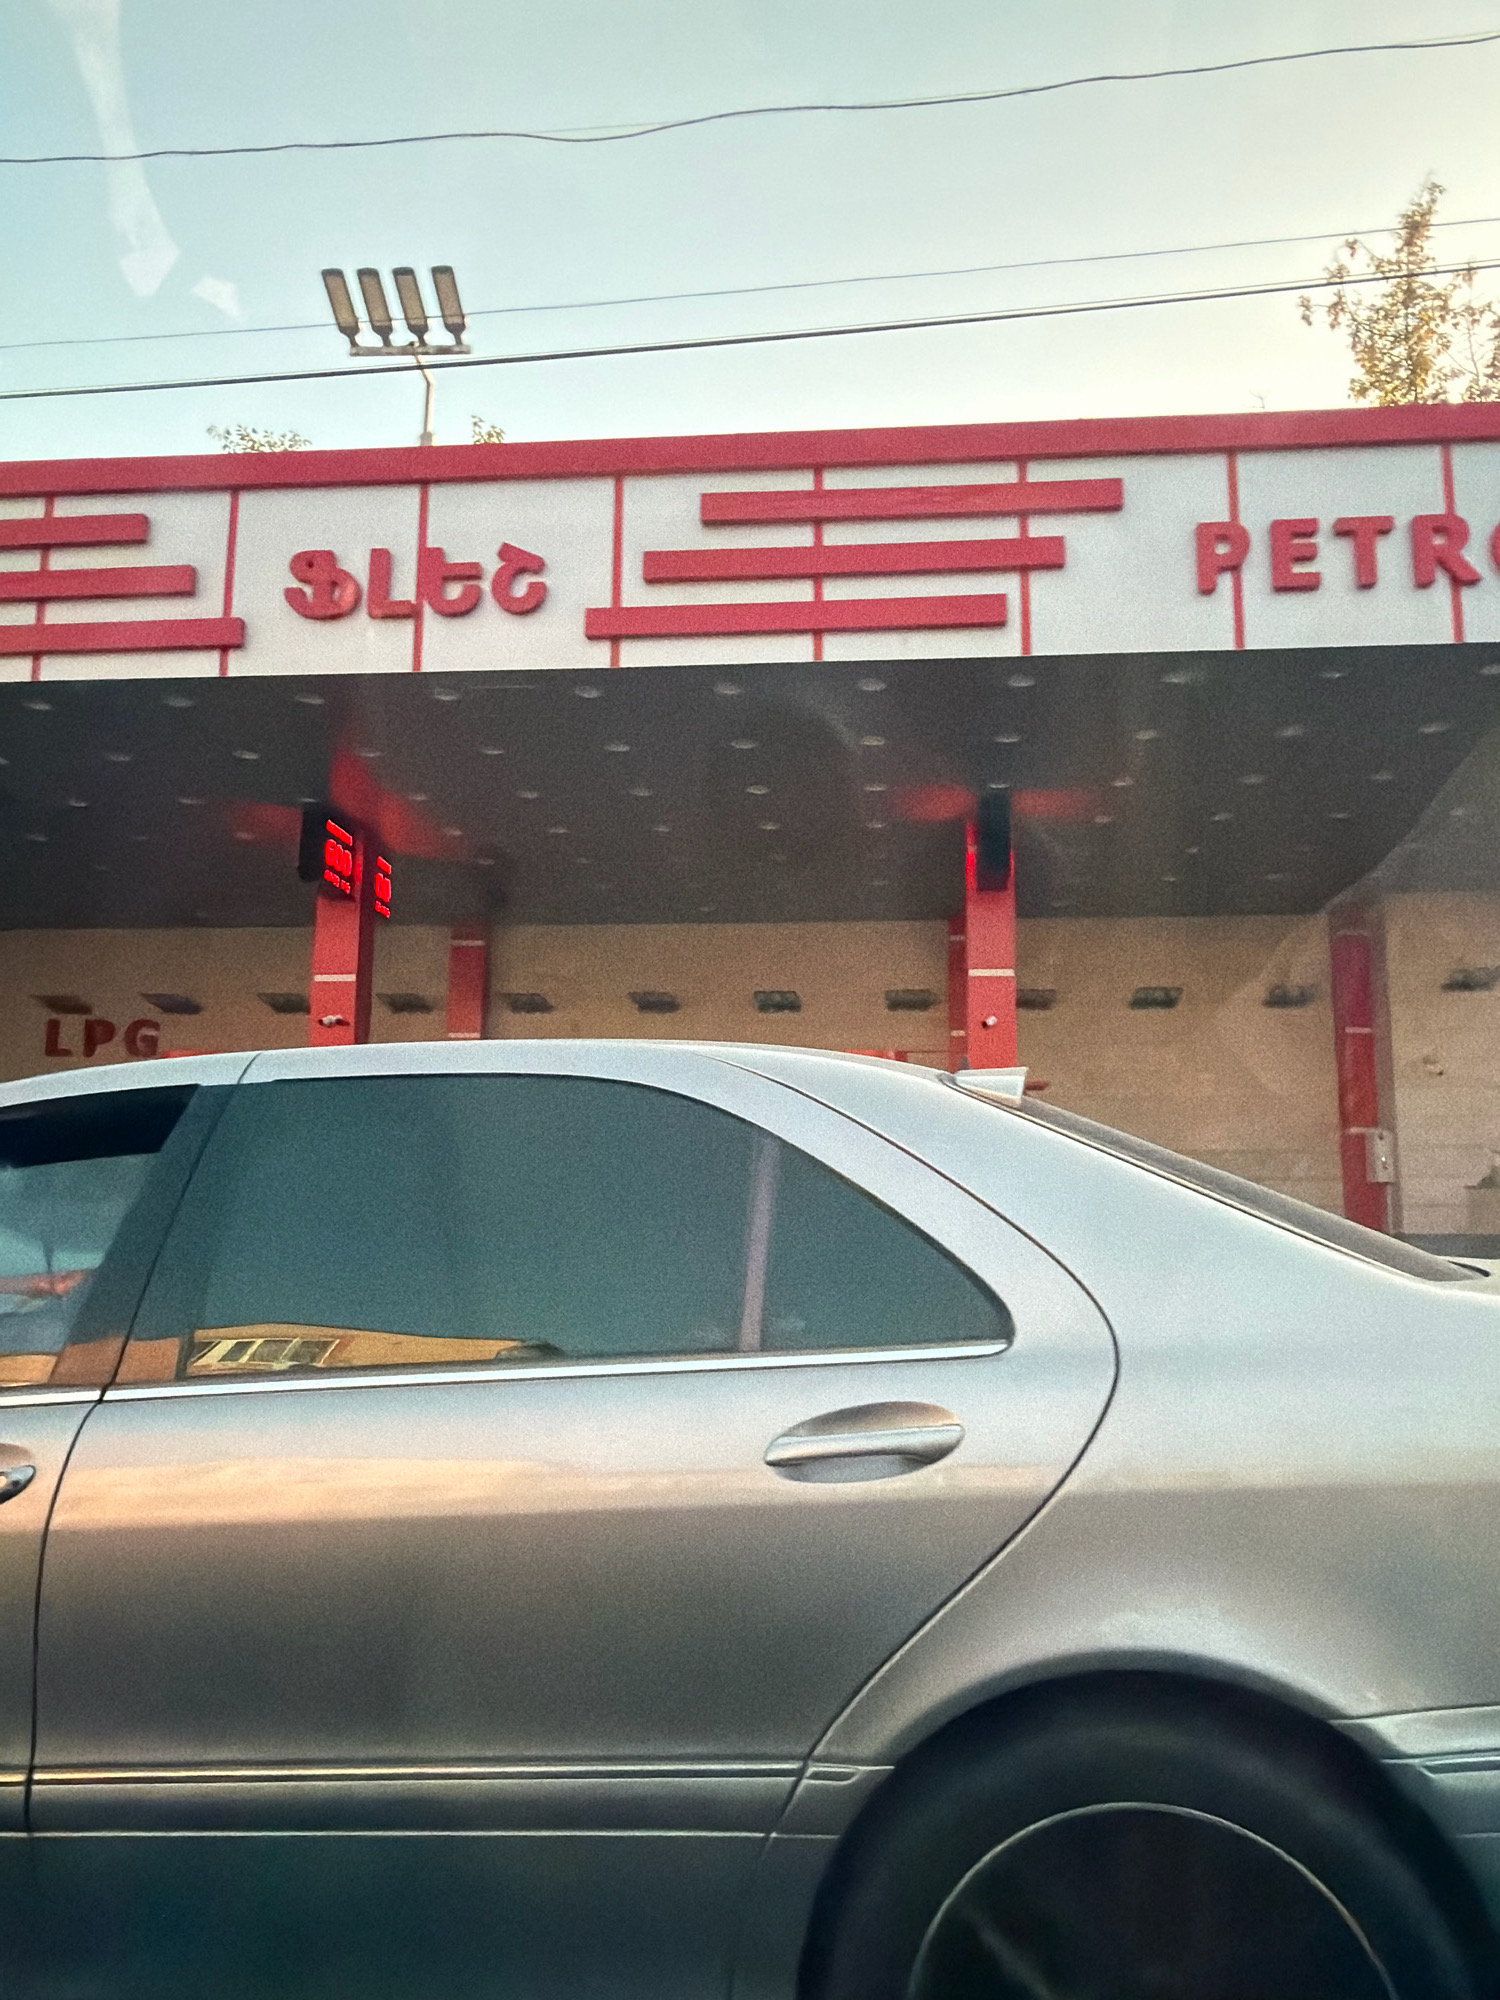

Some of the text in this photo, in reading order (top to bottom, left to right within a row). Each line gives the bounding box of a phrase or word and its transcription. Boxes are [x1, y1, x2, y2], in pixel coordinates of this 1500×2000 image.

[284, 542, 547, 620] ՖԼԵՇ
[1196, 514, 1500, 595] PETR
[45, 1018, 160, 1058] LPG
